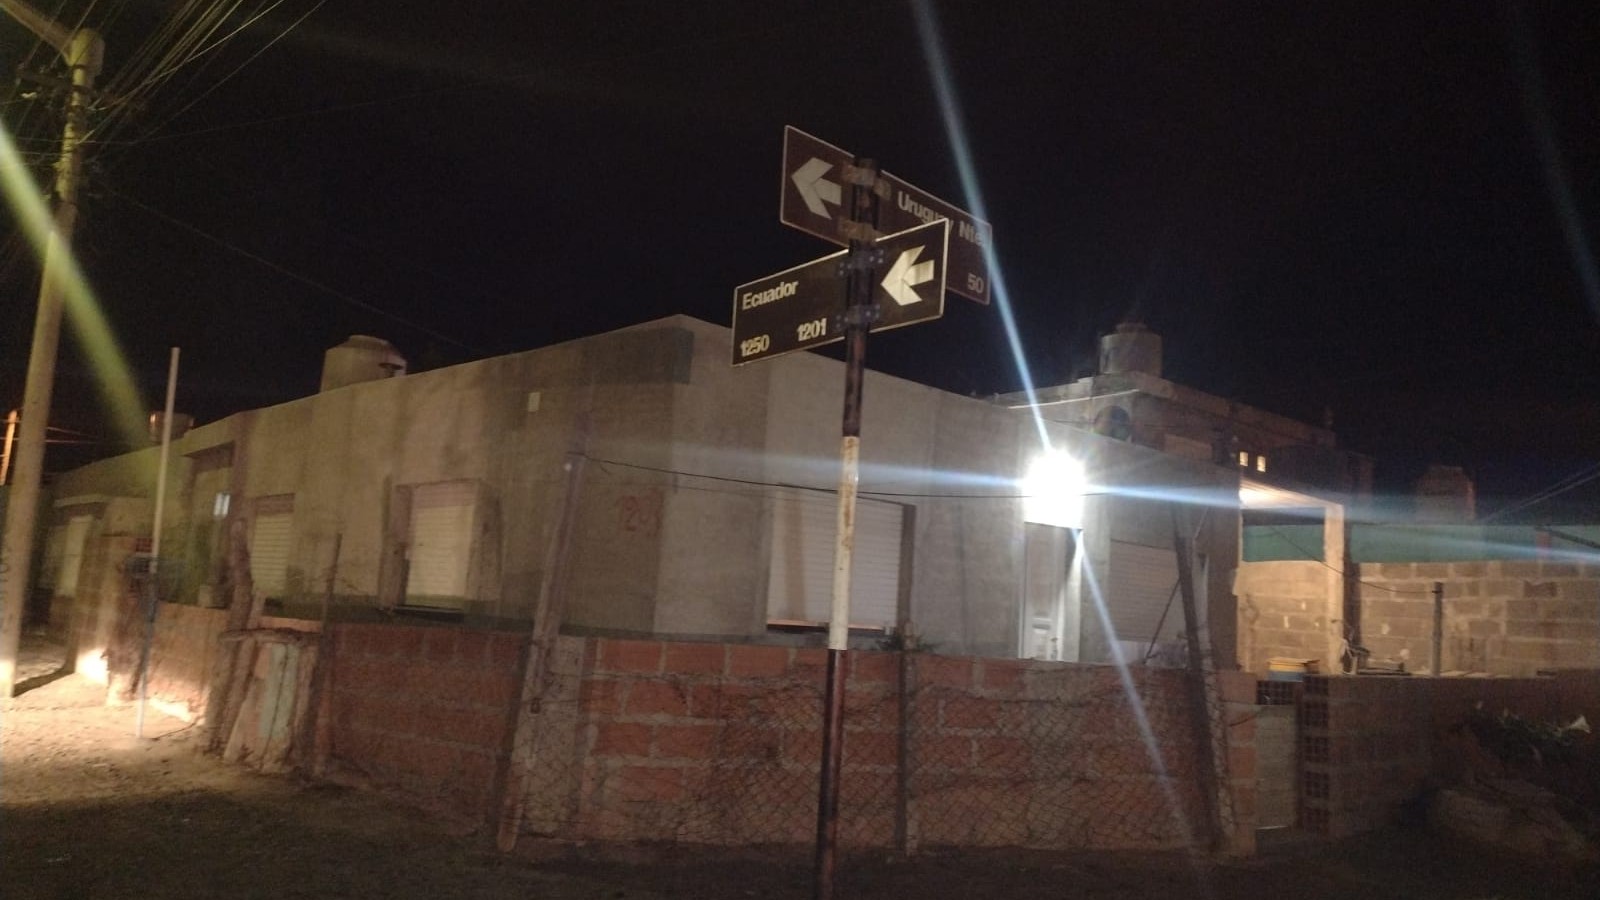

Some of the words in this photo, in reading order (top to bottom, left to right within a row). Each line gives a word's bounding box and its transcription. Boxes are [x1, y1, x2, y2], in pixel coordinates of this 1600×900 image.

[898, 190, 954, 234] Uruguy
[742, 281, 799, 310] Ecuador
[967, 272, 985, 294] 50
[741, 334, 770, 357] 1250
[797, 317, 827, 341] 1201
